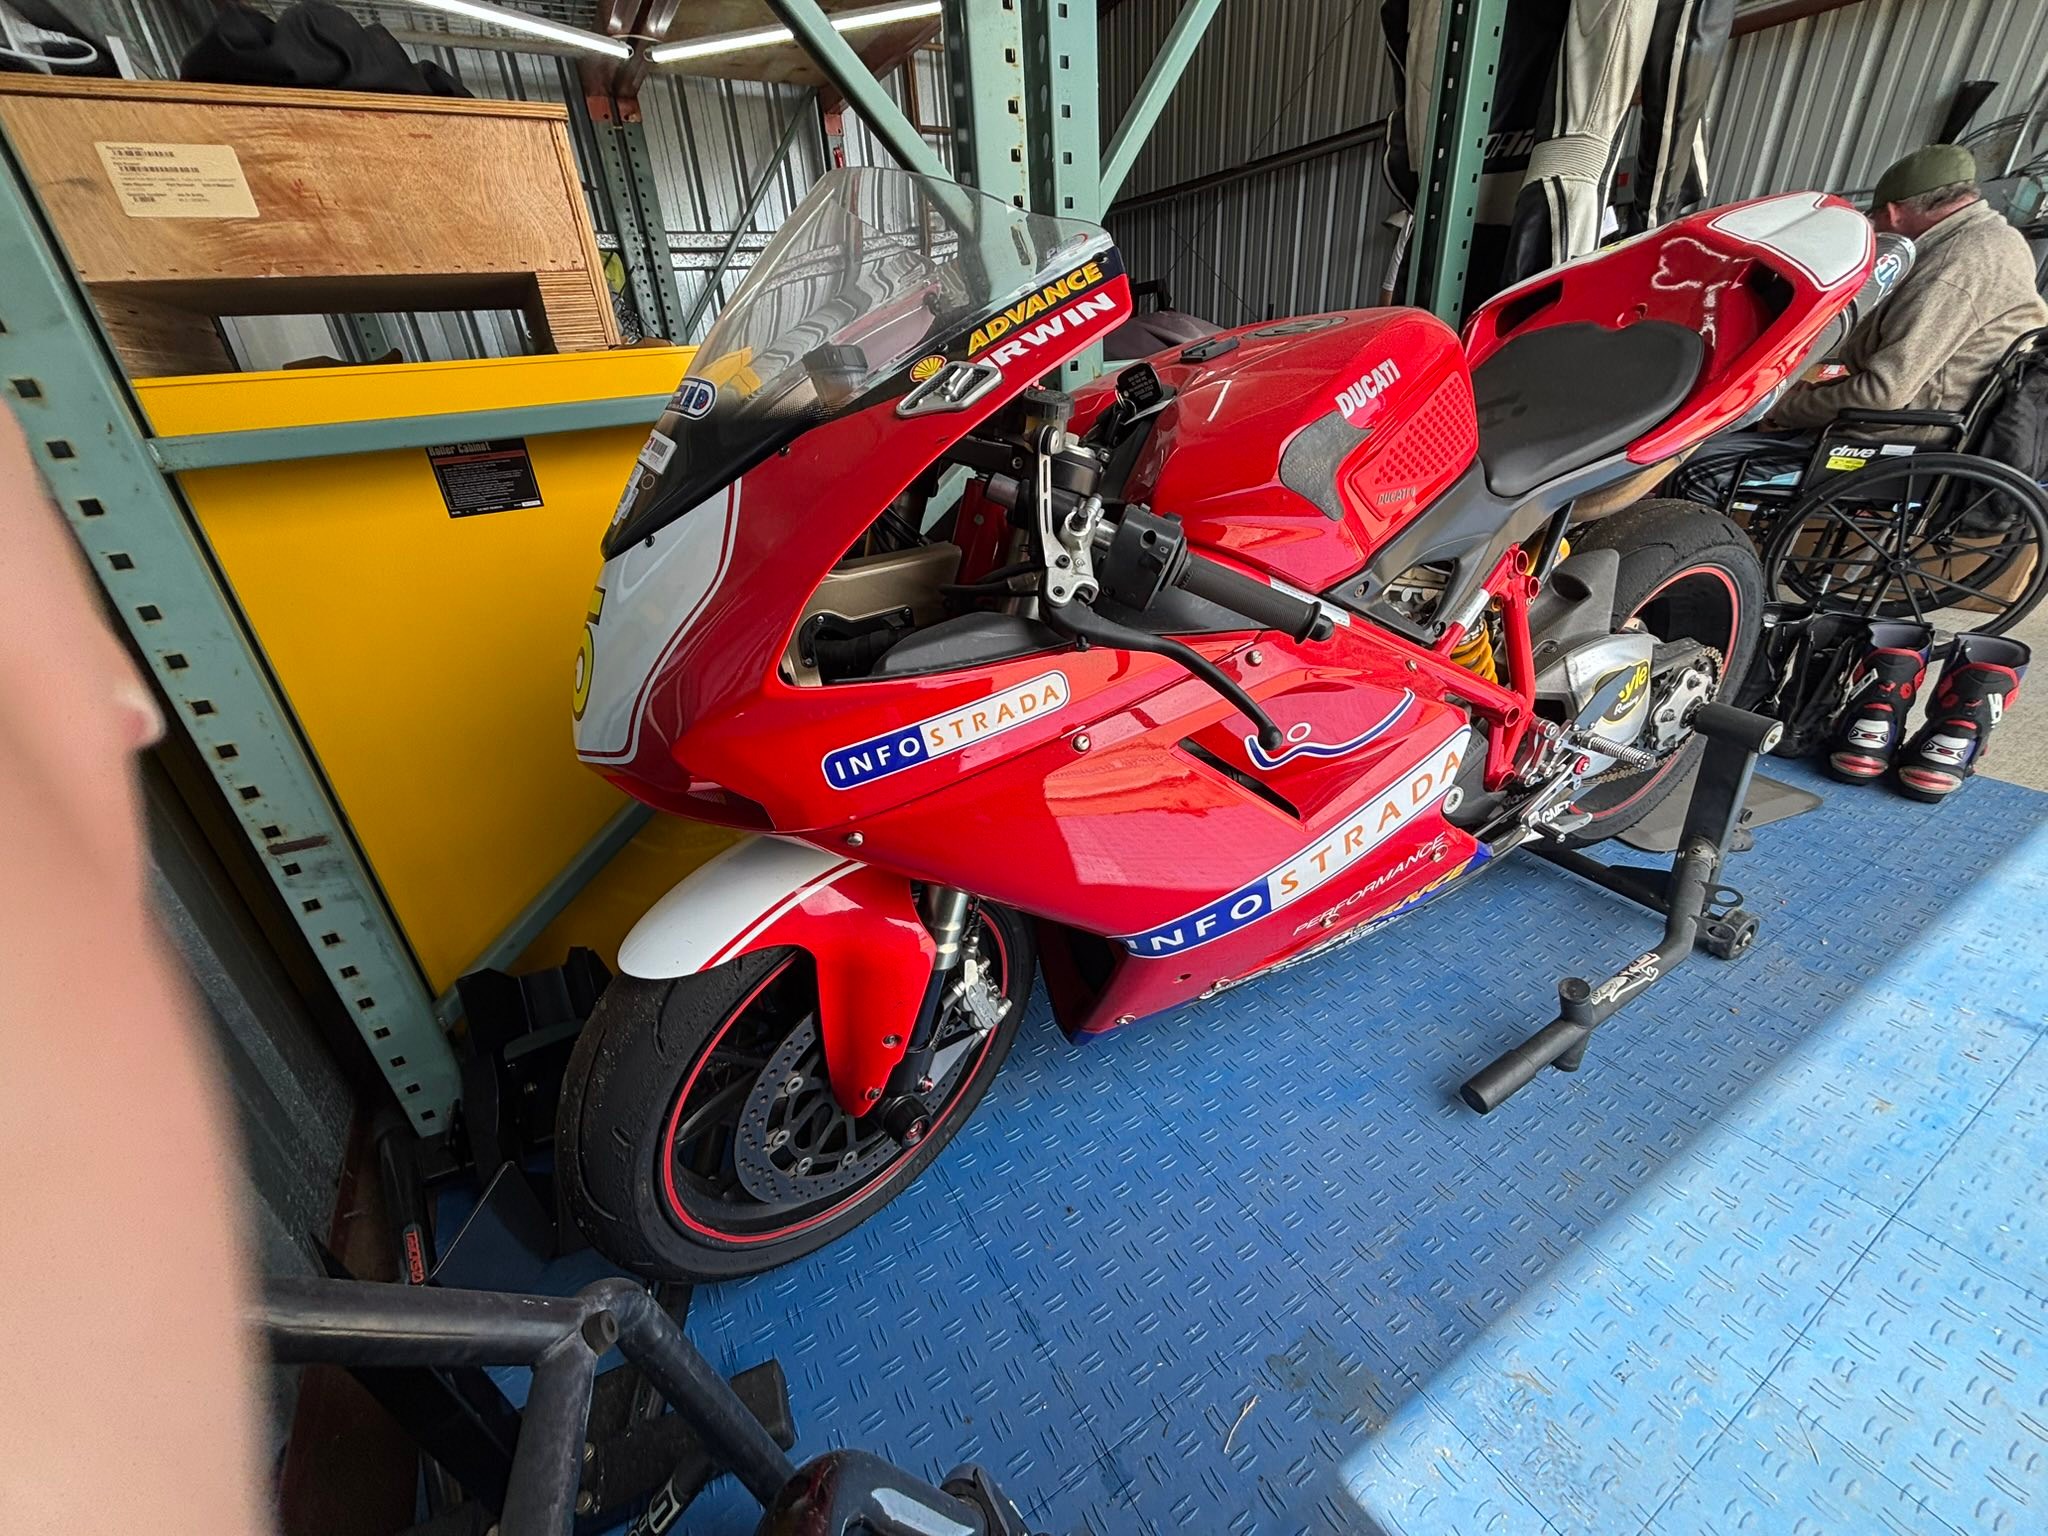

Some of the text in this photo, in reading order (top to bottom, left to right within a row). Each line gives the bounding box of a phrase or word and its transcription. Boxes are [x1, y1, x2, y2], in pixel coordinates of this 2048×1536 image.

[967, 261, 1103, 356] ADVANCE
[1335, 358, 1401, 419] DUCATI
[1829, 444, 1876, 458] drive
[1376, 488, 1410, 505] DUCATI
[1618, 666, 1648, 703] yle
[834, 684, 1060, 780] INFOSTRADA
[1292, 831, 1446, 937] PERFORMANCE
